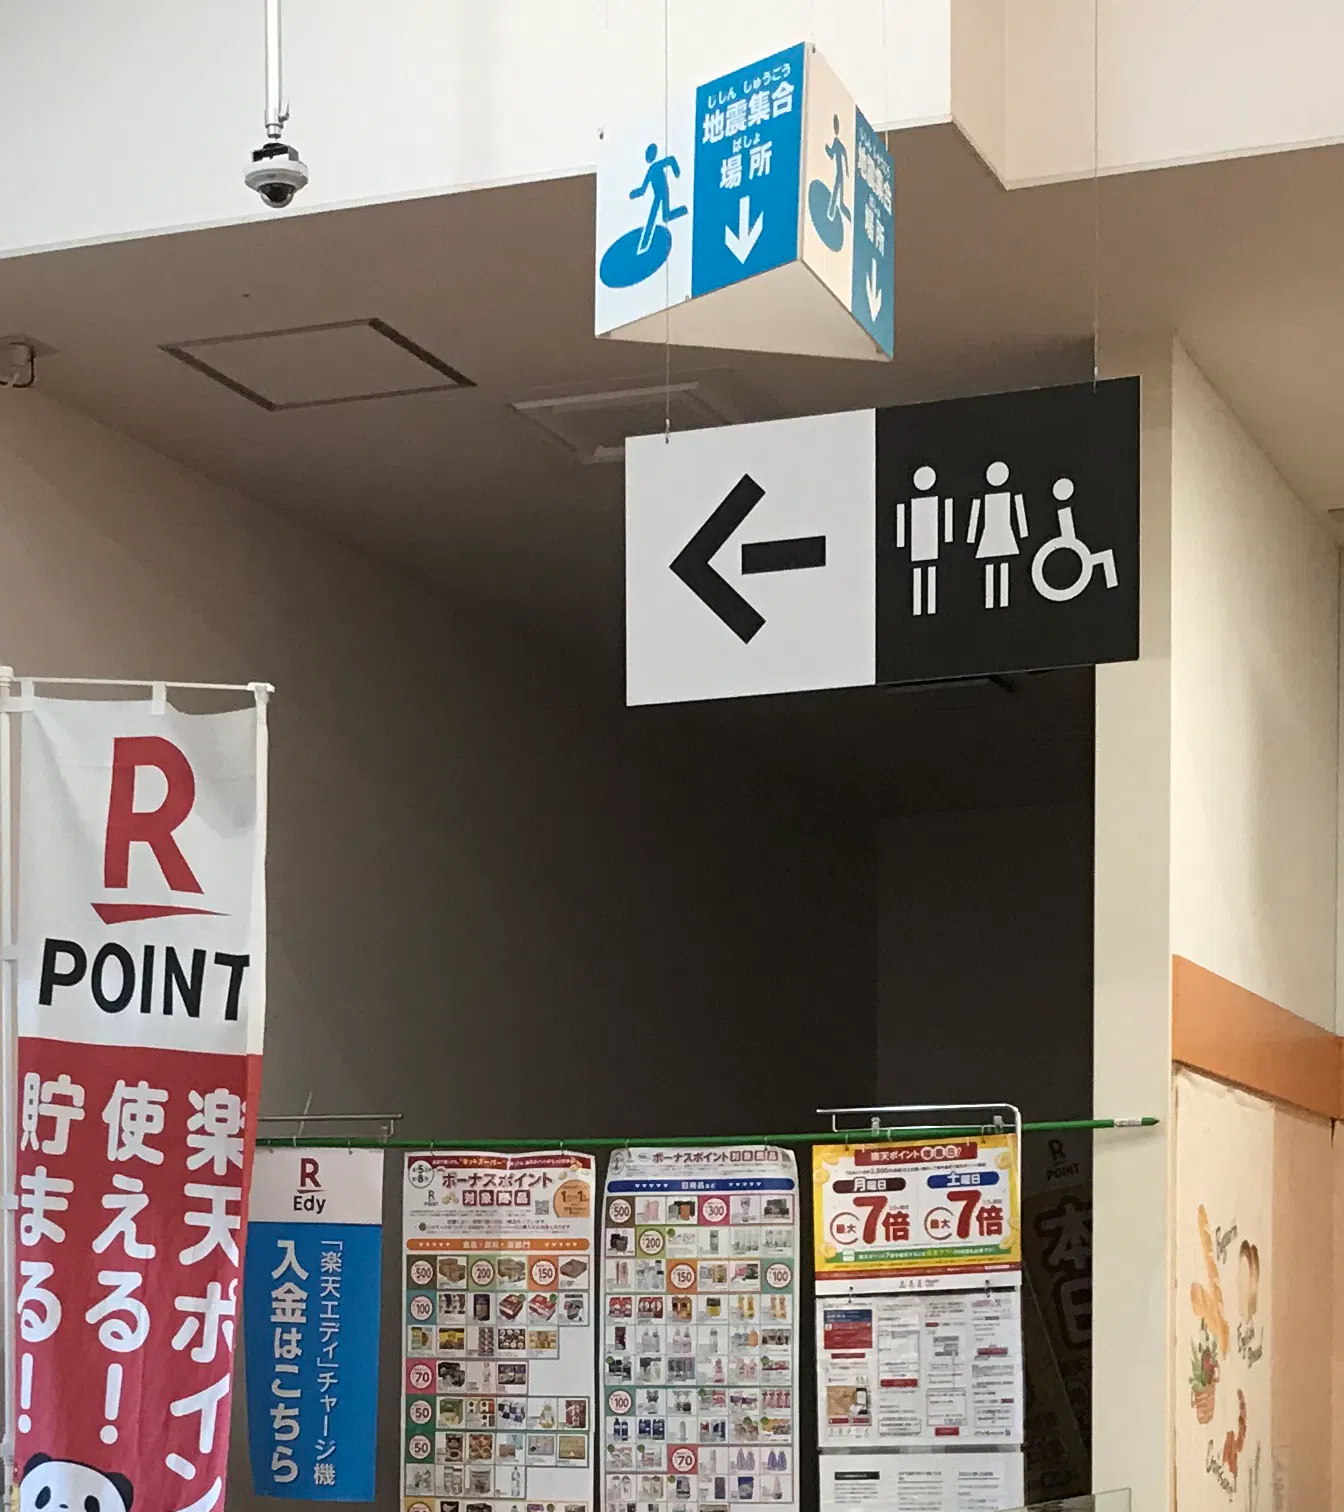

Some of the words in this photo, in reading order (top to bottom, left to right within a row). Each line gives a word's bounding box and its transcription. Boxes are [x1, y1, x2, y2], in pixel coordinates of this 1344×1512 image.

[708, 87, 736, 108] じしん
[744, 63, 790, 93] しゅうごう
[702, 81, 794, 143] 地震集合
[719, 141, 772, 188] 場所
[732, 133, 760, 152] ばしょ
[104, 736, 204, 894] R
[39, 938, 250, 1021] POINT
[300, 1158, 321, 1188] R
[442, 1173, 553, 1188] ボーナスポイント
[853, 1176, 887, 1192] 月曜日
[946, 1171, 981, 1187] 土曜日
[1047, 1163, 1080, 1180] POINT
[293, 1195, 326, 1215] Edy
[17, 1072, 86, 1433] 貯まる！
[84, 1079, 168, 1445] 使える！
[270, 1240, 309, 1483] 入金はこちら
[314, 1240, 343, 1486] 「楽天エディ」チャージ機
